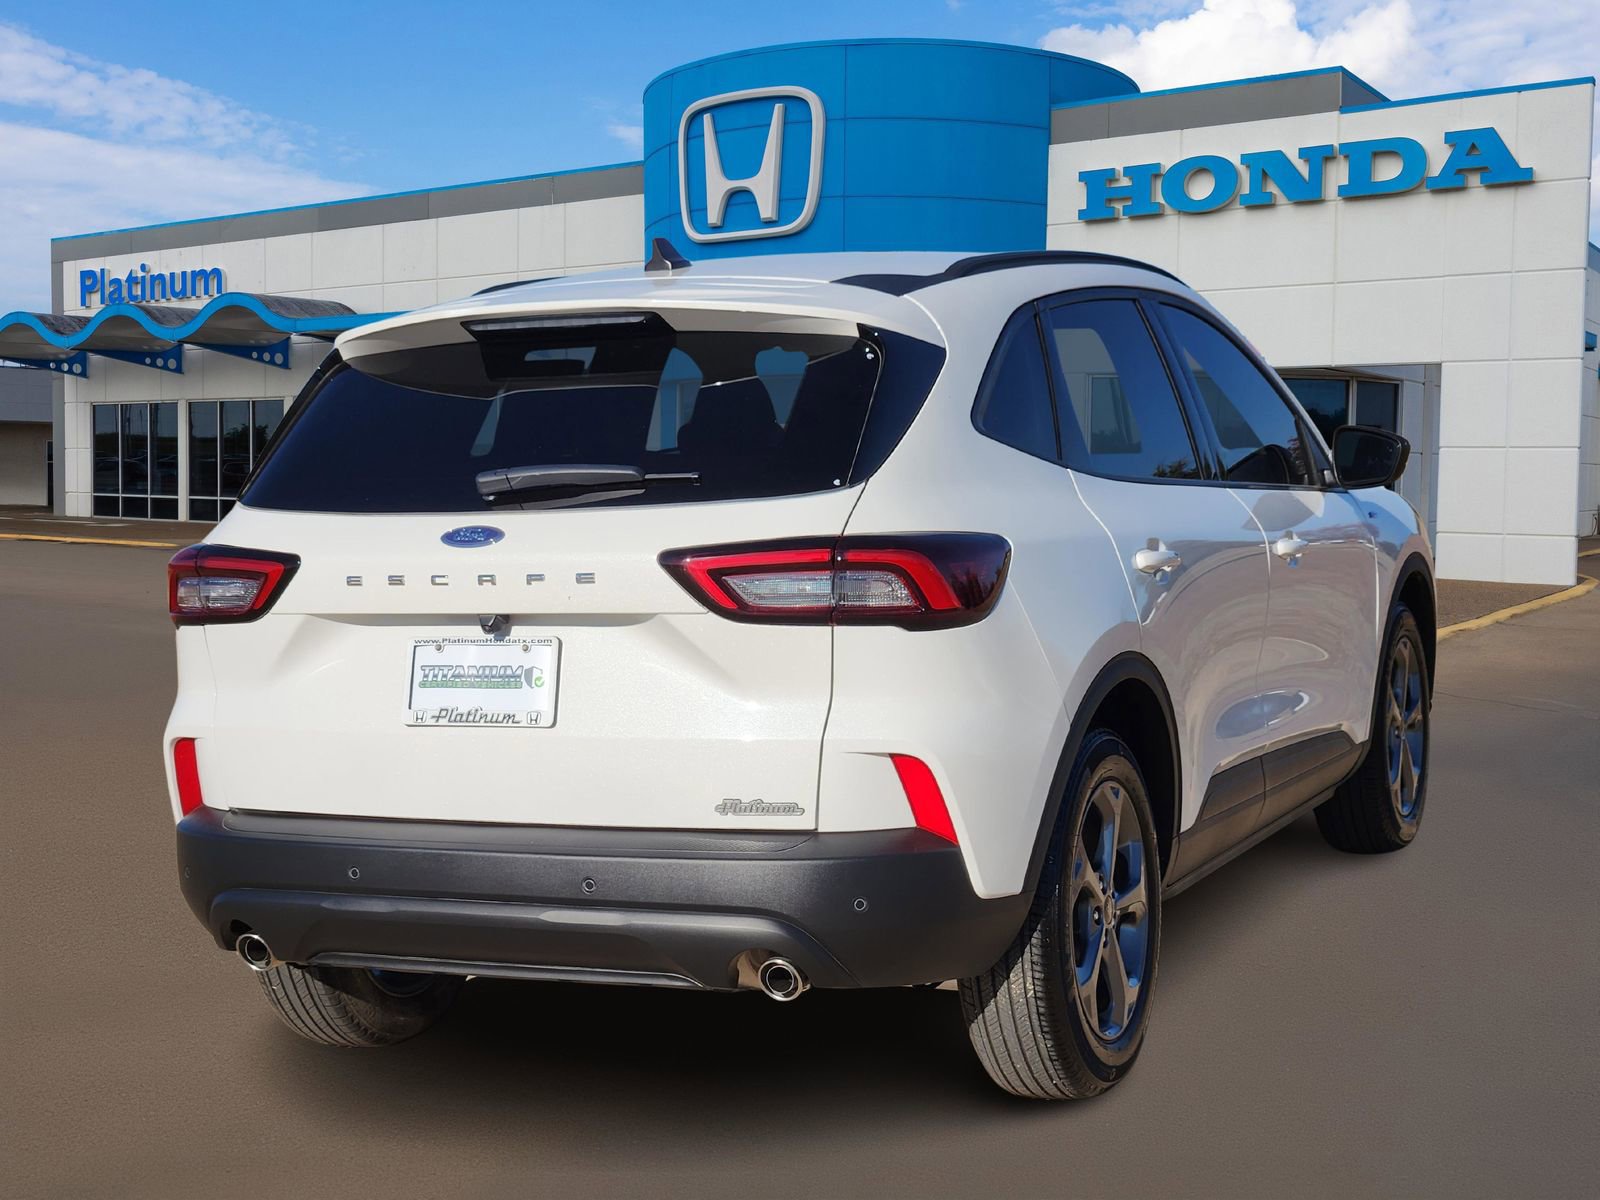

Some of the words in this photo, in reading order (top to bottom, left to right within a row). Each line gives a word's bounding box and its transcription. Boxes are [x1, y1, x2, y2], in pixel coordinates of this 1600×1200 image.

[1078, 127, 1535, 224] HONDA
[79, 263, 227, 307] Platinum
[346, 572, 596, 586] ESCAPE
[420, 665, 524, 681] TITANIUM
[431, 707, 522, 724] Platinum
